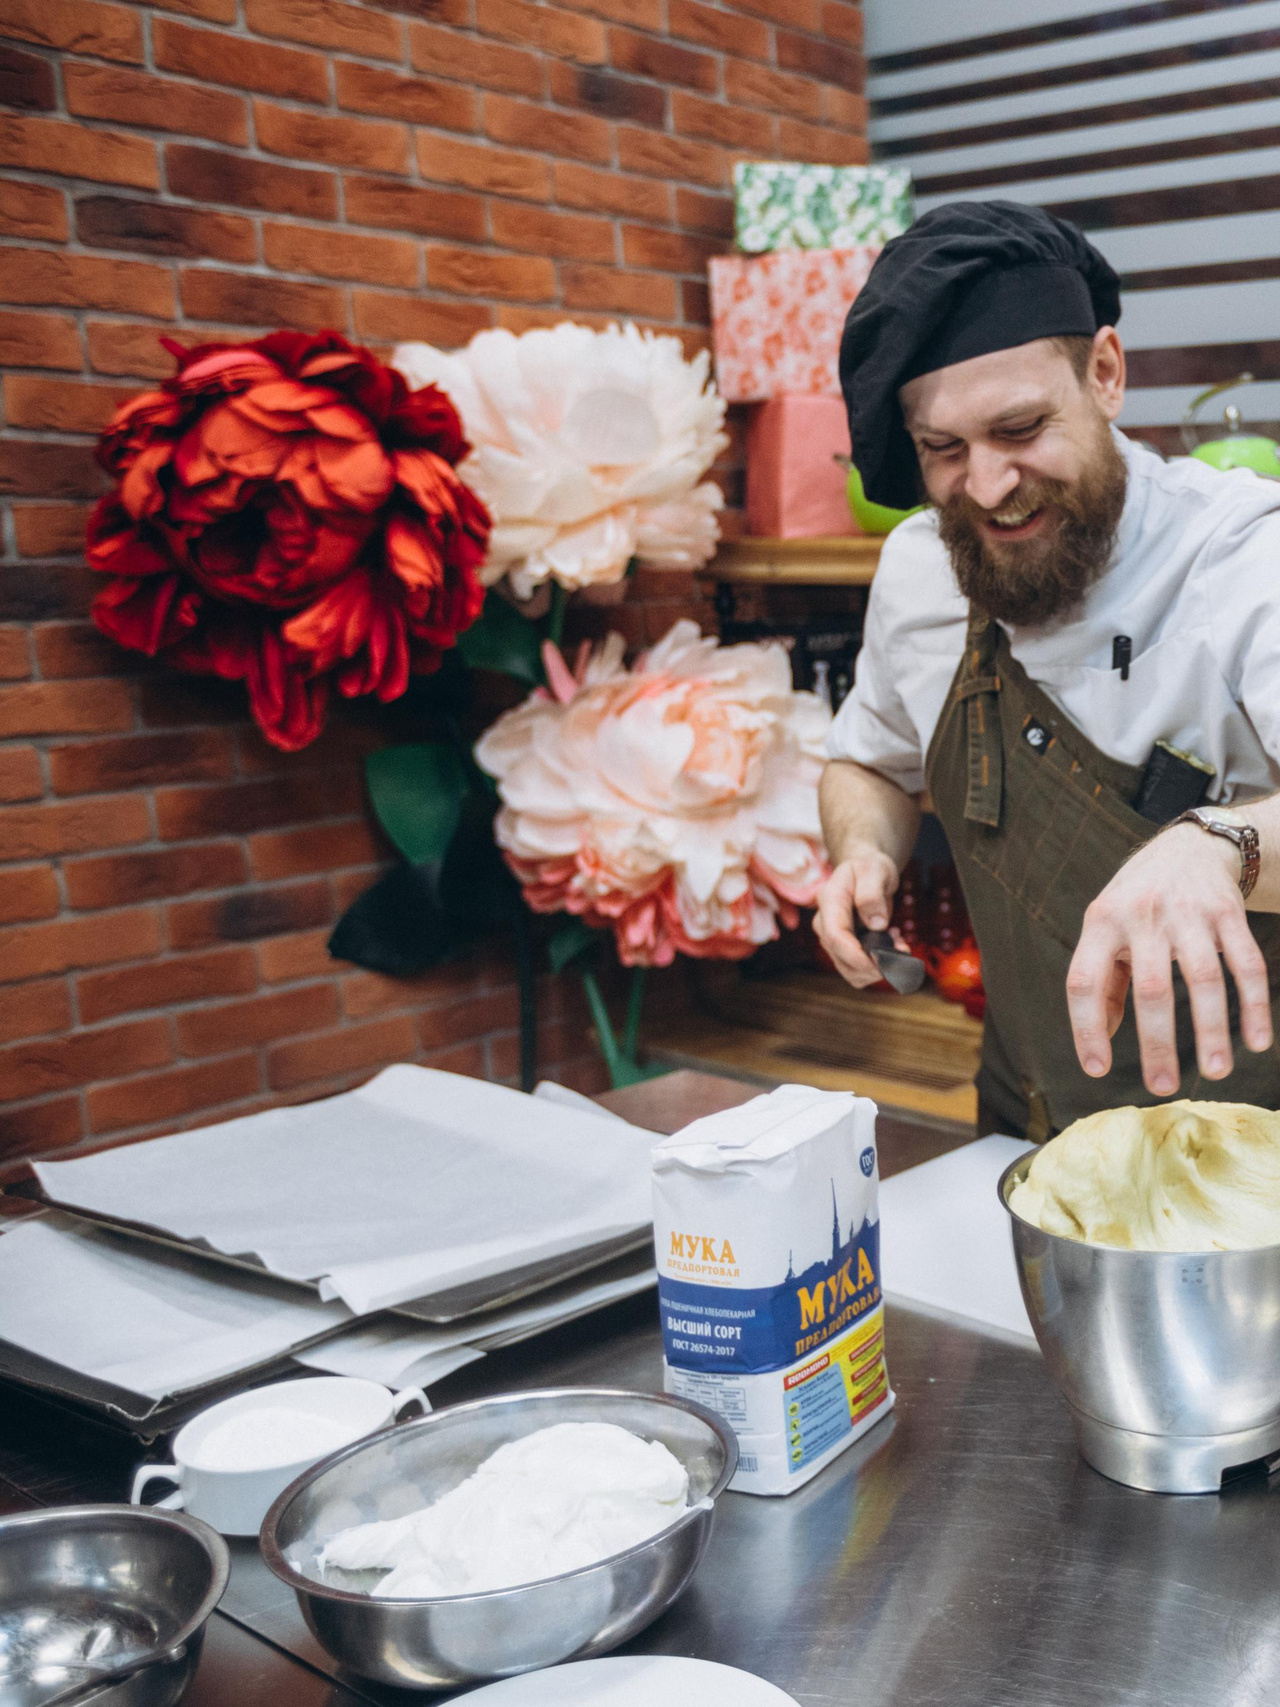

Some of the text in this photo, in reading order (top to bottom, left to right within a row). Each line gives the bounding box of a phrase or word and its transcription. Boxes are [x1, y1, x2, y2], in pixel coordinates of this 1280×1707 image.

[670, 1230, 736, 1264] МУКА
[667, 1258, 740, 1278] ПРЕДПОРТОВАЯ
[797, 1247, 875, 1331] МУКА
[704, 1306, 756, 1320] ХЛЕБОПЕКАРНАЯ
[667, 1316, 742, 1340] ВЫСШИЙ СОРТ
[672, 1338, 736, 1356] ГОСТ 26574-2017
